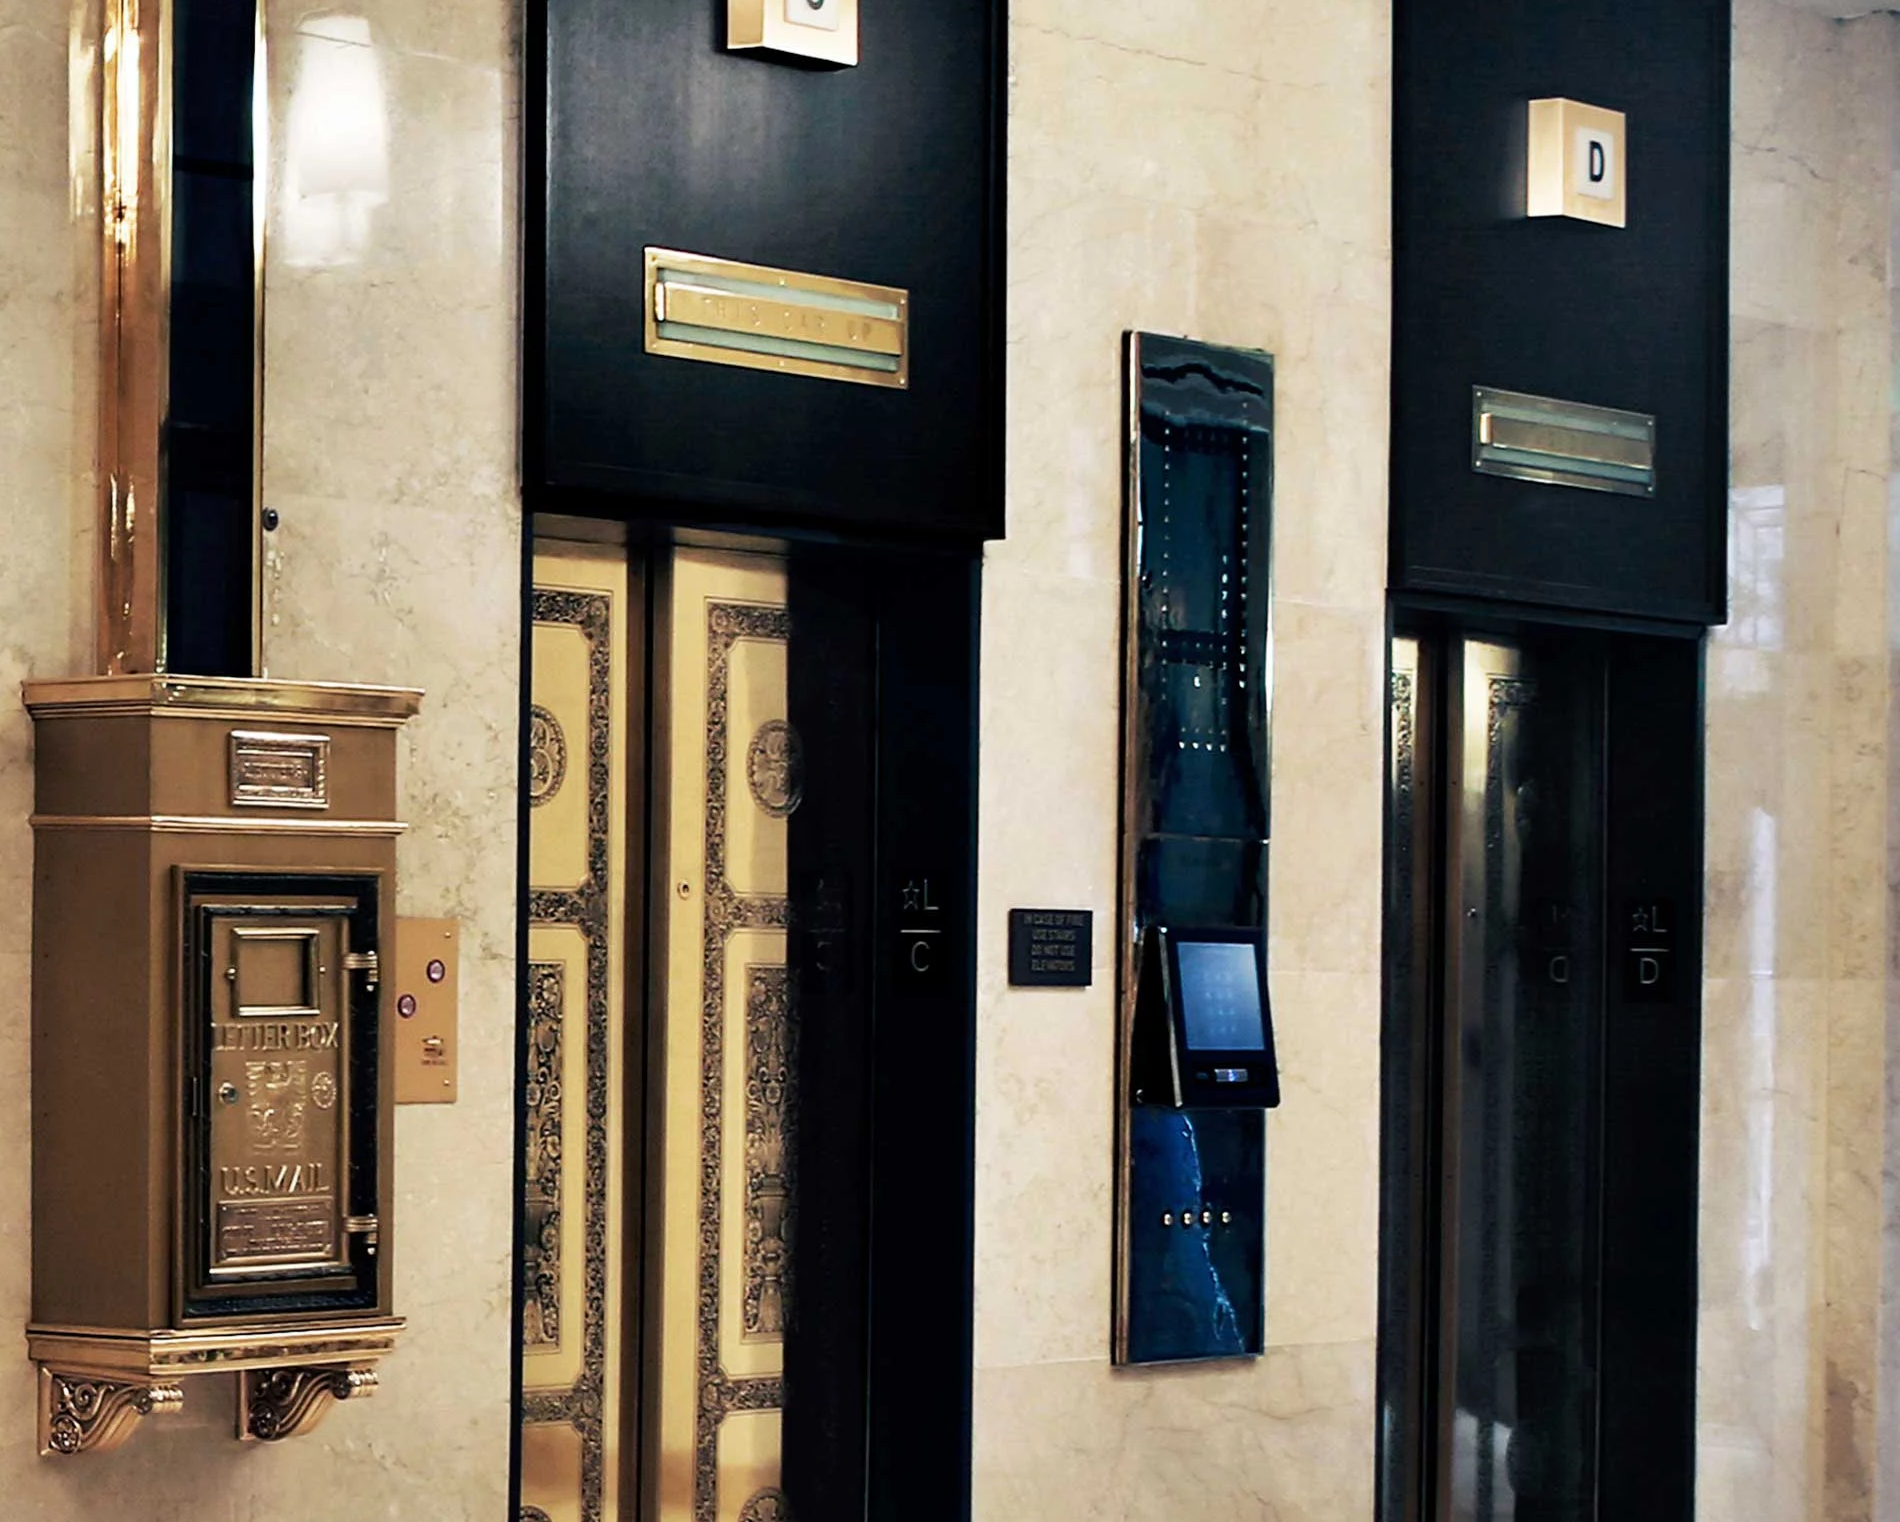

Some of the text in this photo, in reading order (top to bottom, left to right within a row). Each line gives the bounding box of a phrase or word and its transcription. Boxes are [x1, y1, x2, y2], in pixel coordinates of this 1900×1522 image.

[1589, 140, 1605, 183] D
[923, 878, 939, 911] L
[1652, 906, 1668, 933] L
[911, 941, 929, 972] C
[1640, 958, 1659, 984] D
[211, 1021, 338, 1052] LETTER BOX
